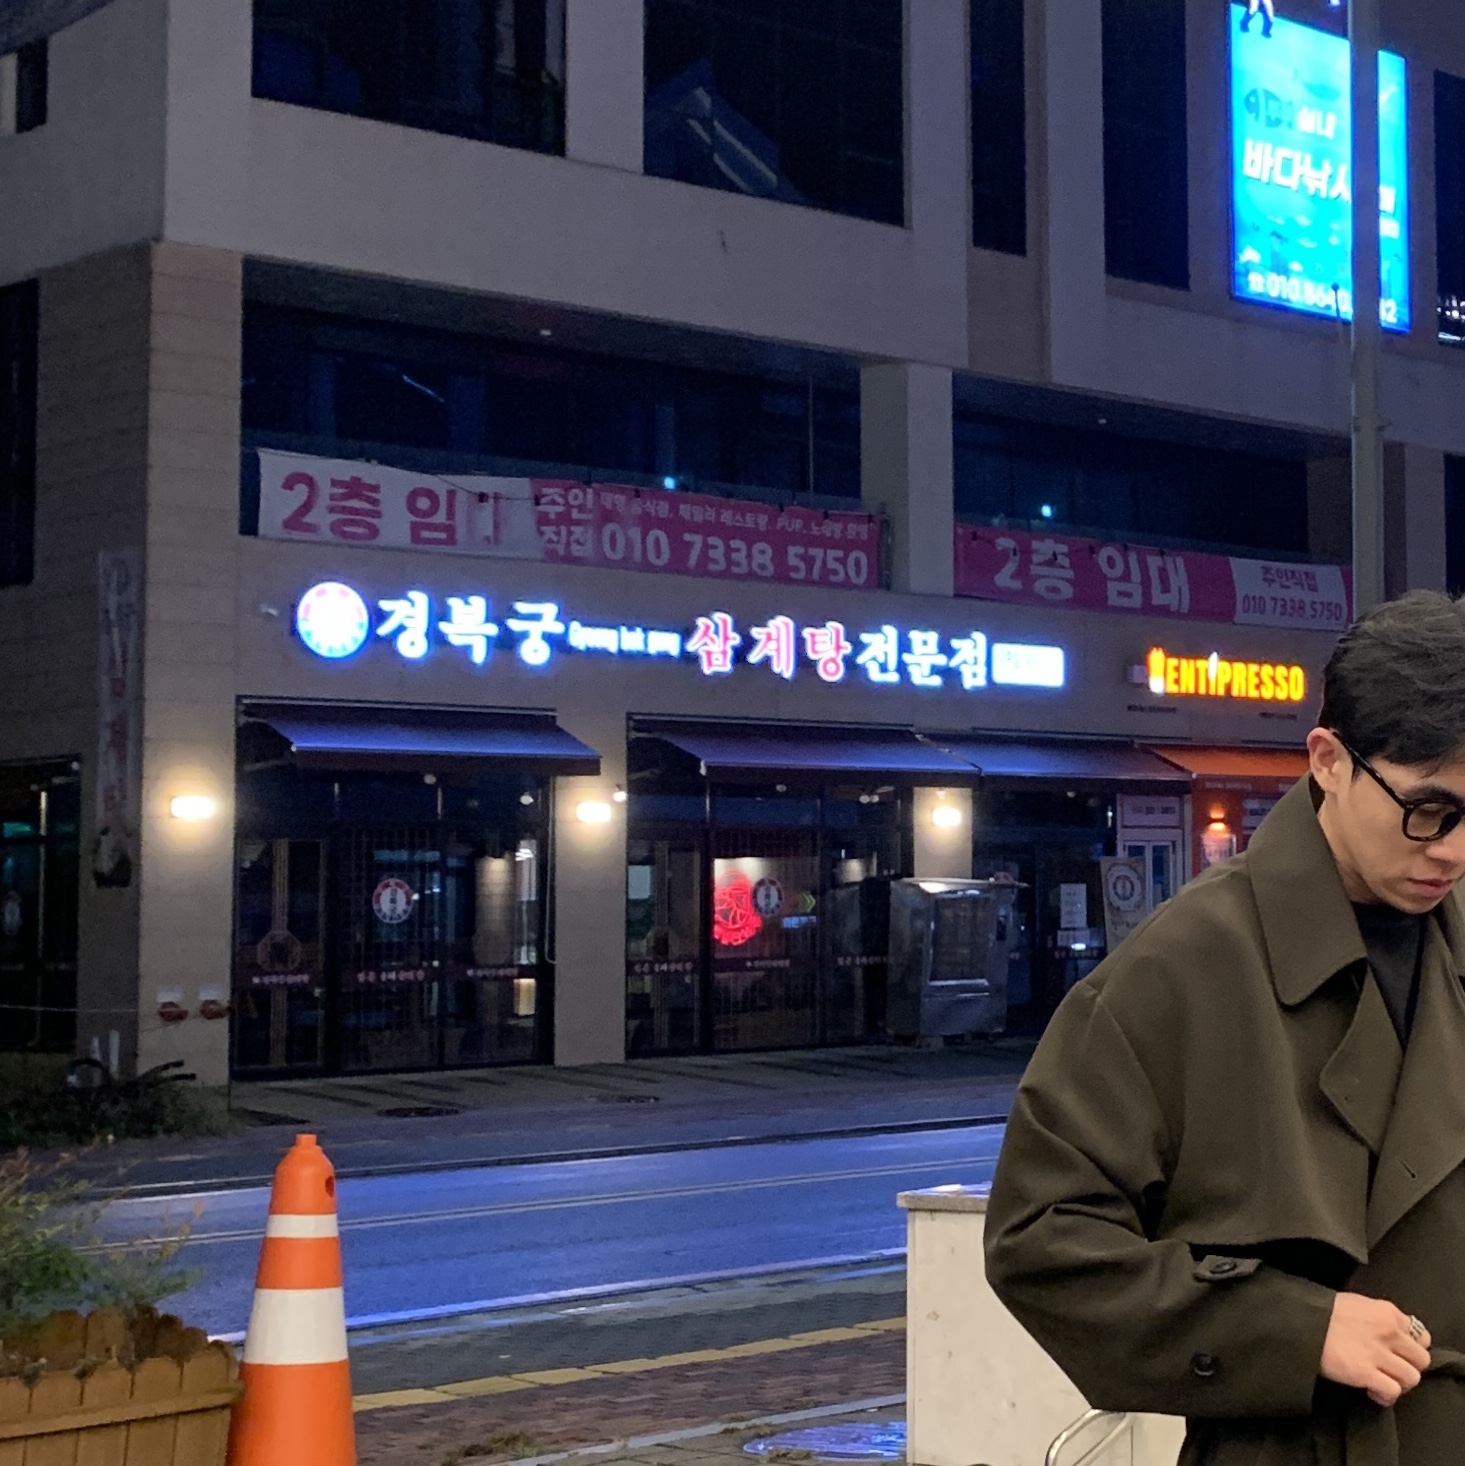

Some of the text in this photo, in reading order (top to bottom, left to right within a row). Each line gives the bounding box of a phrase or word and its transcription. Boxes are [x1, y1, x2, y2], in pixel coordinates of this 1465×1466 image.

[281, 471, 500, 547] 2층 임
[535, 487, 594, 520] 주인
[539, 525, 594, 556] 직접
[602, 523, 868, 585] 010 7338 5750
[993, 537, 1190, 614] 2층 임대
[376, 590, 565, 665] 경복궁
[1242, 594, 1343, 621] 010 7338 5750
